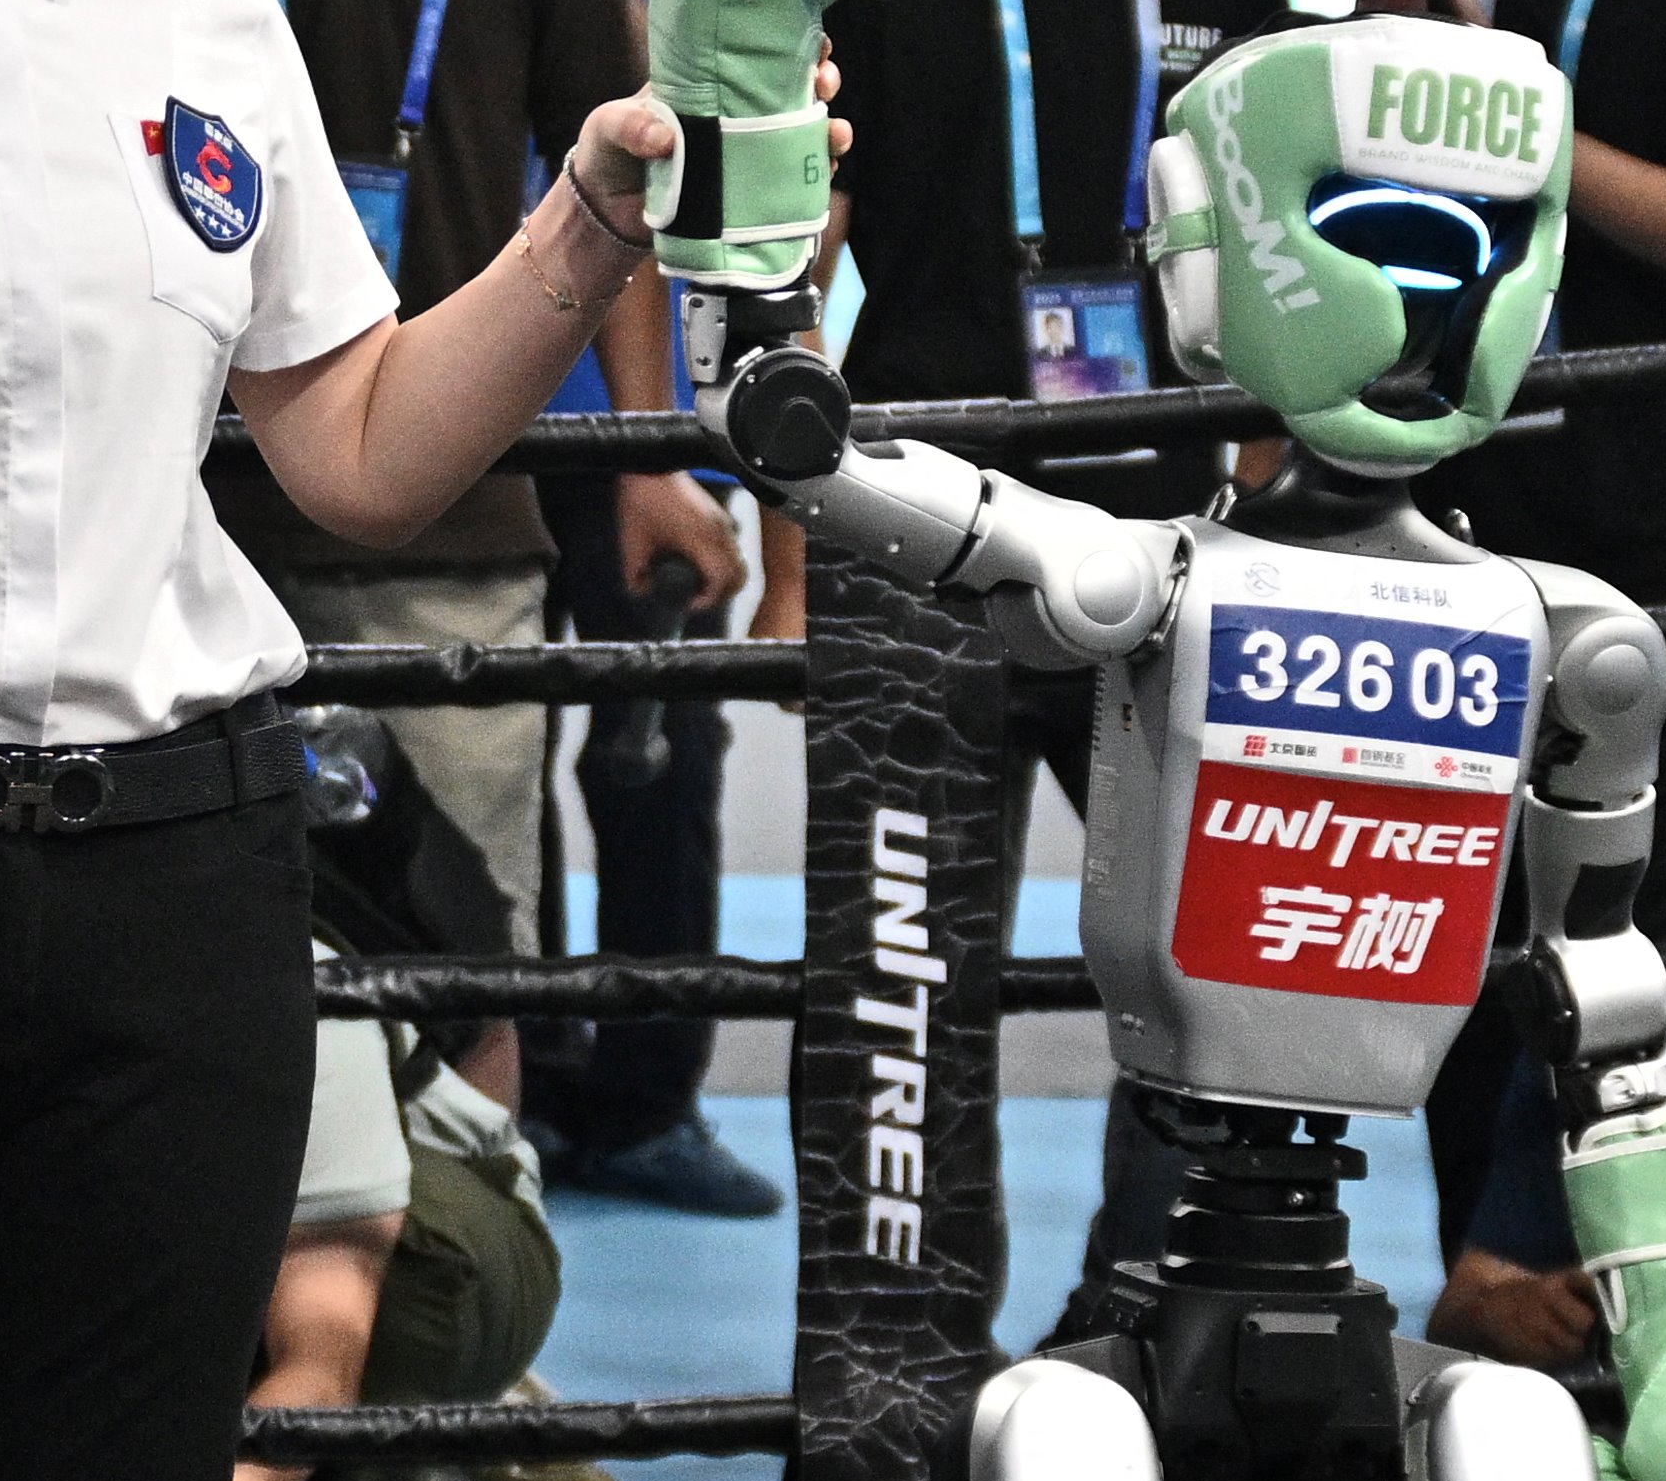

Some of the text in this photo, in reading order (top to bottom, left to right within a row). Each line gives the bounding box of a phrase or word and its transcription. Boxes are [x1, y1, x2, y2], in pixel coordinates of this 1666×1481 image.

[1366, 63, 1543, 164] FORCE
[1208, 67, 1321, 315] BOOM!
[1370, 581, 1453, 610] 北信科队
[1240, 629, 1499, 727] 326 03
[1203, 798, 1500, 869] UNITREE
[1249, 885, 1446, 975] 宇树
[854, 806, 948, 1266] UNITREE
